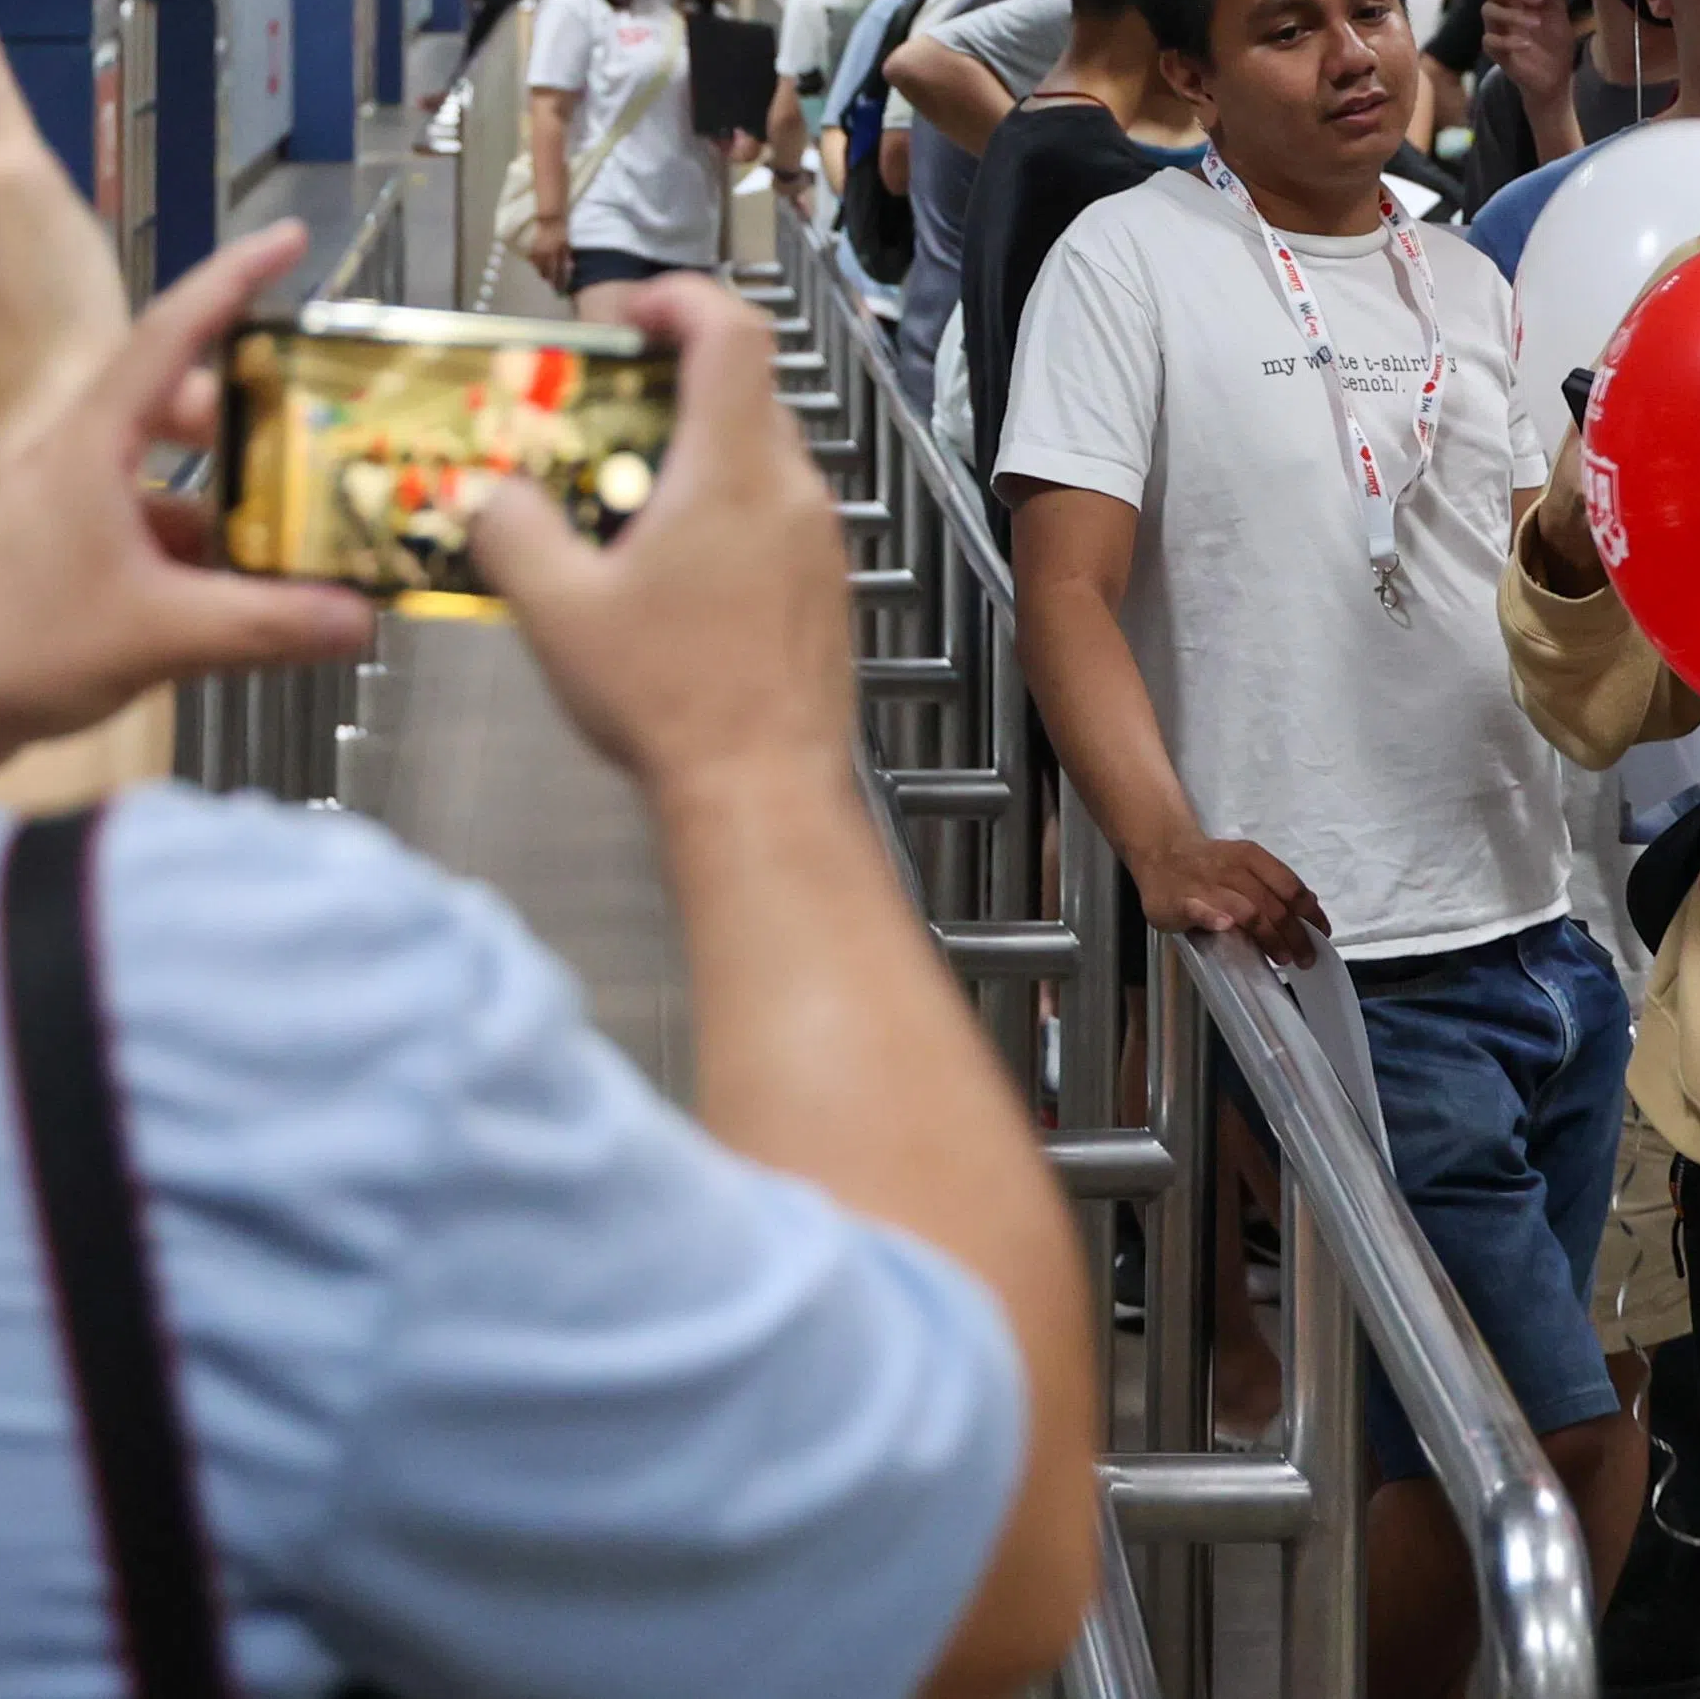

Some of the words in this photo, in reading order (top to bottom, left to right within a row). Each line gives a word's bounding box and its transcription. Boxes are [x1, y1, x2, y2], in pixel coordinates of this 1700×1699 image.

[1261, 355, 1297, 377] my
[1304, 353, 1359, 372] wte
[1365, 353, 1431, 372] t-shirt
